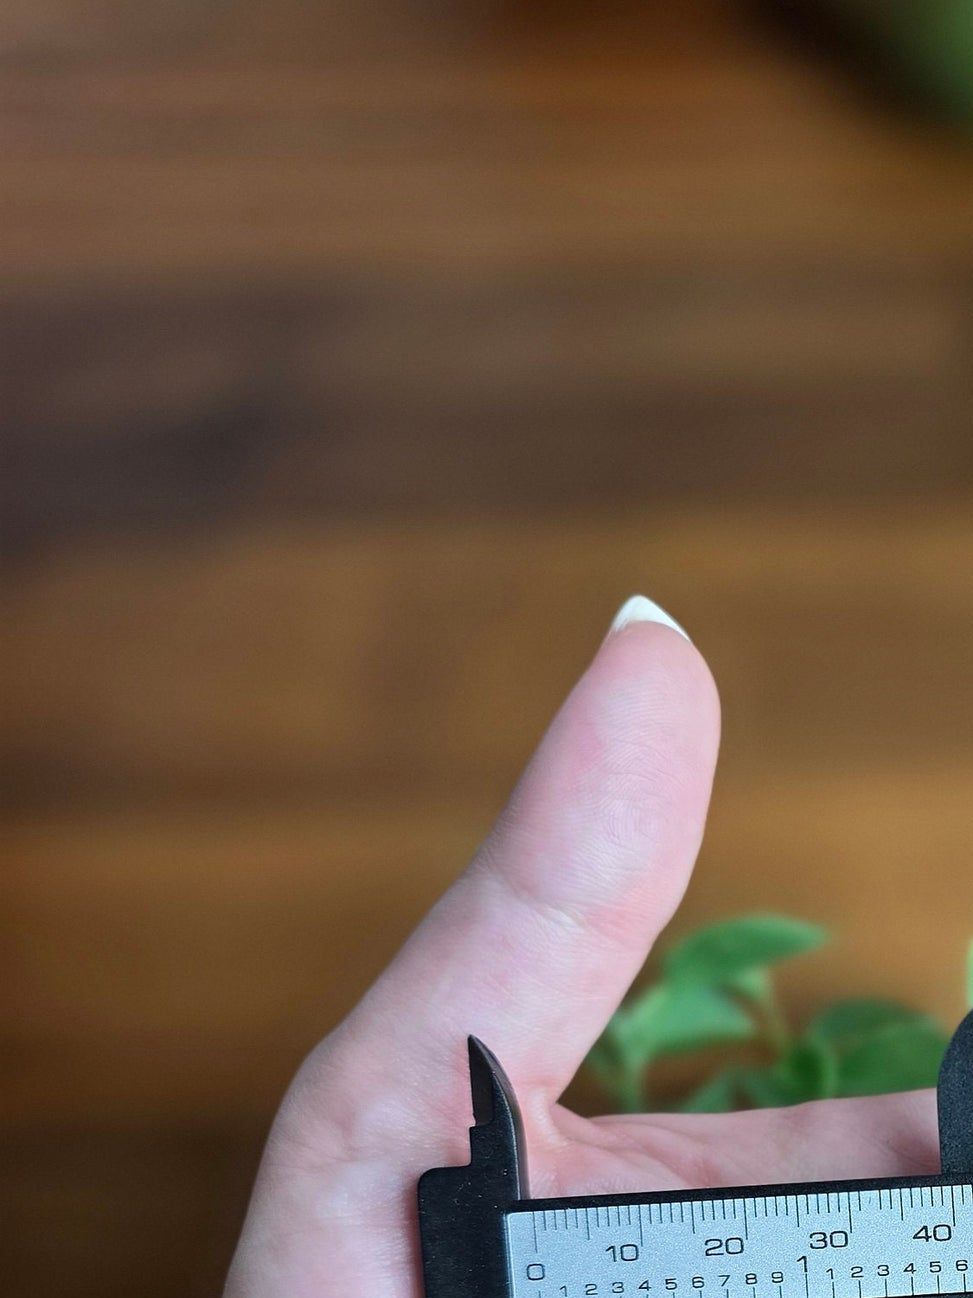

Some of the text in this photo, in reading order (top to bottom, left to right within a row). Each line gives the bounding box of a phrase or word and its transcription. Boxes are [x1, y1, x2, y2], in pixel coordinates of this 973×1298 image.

[526, 1263, 546, 1281] 0
[604, 1243, 640, 1262] 10
[704, 1236, 745, 1257] 20
[808, 1230, 849, 1250] 30
[912, 1224, 952, 1243] 40
[558, 1285, 568, 1298] 1
[584, 1283, 599, 1296] 2
[611, 1281, 625, 1294] 3
[638, 1279, 652, 1291] 4
[665, 1277, 678, 1290] 5
[691, 1276, 705, 1289] 6
[718, 1274, 731, 1287] 7
[745, 1273, 758, 1285] 8
[771, 1271, 784, 1284] 9
[796, 1255, 808, 1273] 1
[825, 1268, 835, 1280] 1
[851, 1266, 864, 1279] 2
[877, 1264, 890, 1277] 3
[903, 1262, 917, 1275] 4
[929, 1261, 942, 1273] 5
[955, 1259, 969, 1272] 6
